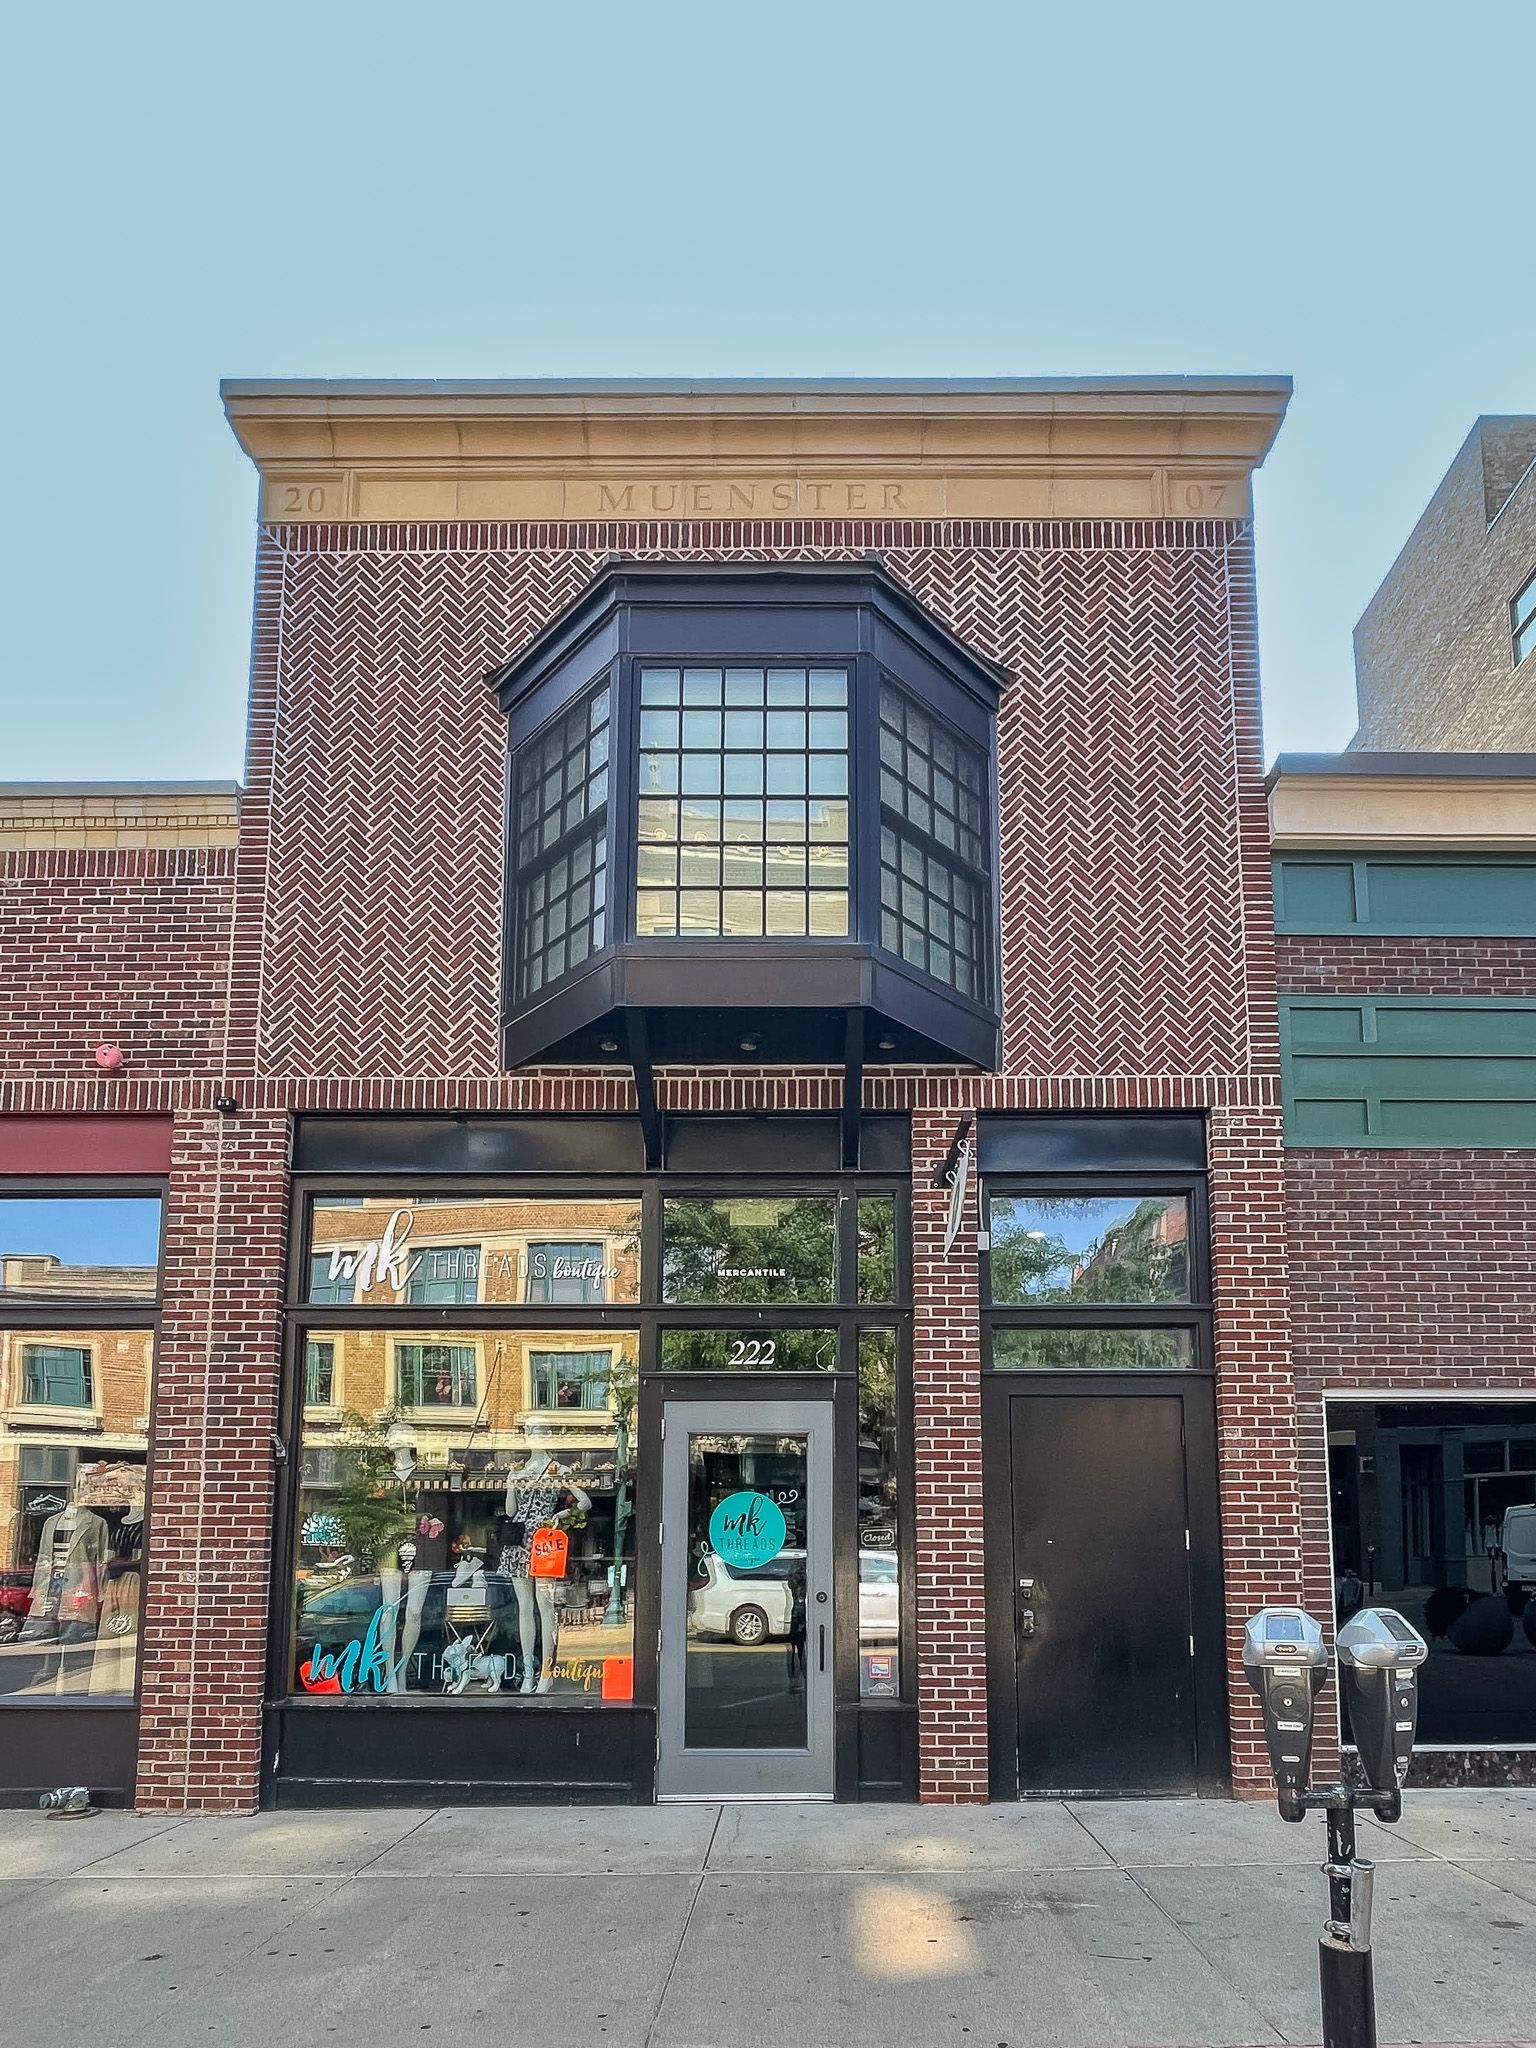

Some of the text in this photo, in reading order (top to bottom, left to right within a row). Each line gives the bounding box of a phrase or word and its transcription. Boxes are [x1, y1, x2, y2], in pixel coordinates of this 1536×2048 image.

[285, 487, 325, 512] 20
[598, 484, 907, 512] MUENSTER
[1185, 485, 1226, 509] 07
[328, 1208, 620, 1291] mk THREADS boutique
[717, 1269, 786, 1277] MERCANTILE
[728, 1340, 776, 1365] 222
[723, 1496, 767, 1536] mk
[720, 1538, 776, 1550] THREADS
[864, 1533, 892, 1542] Closed
[310, 1604, 406, 1693] mk
